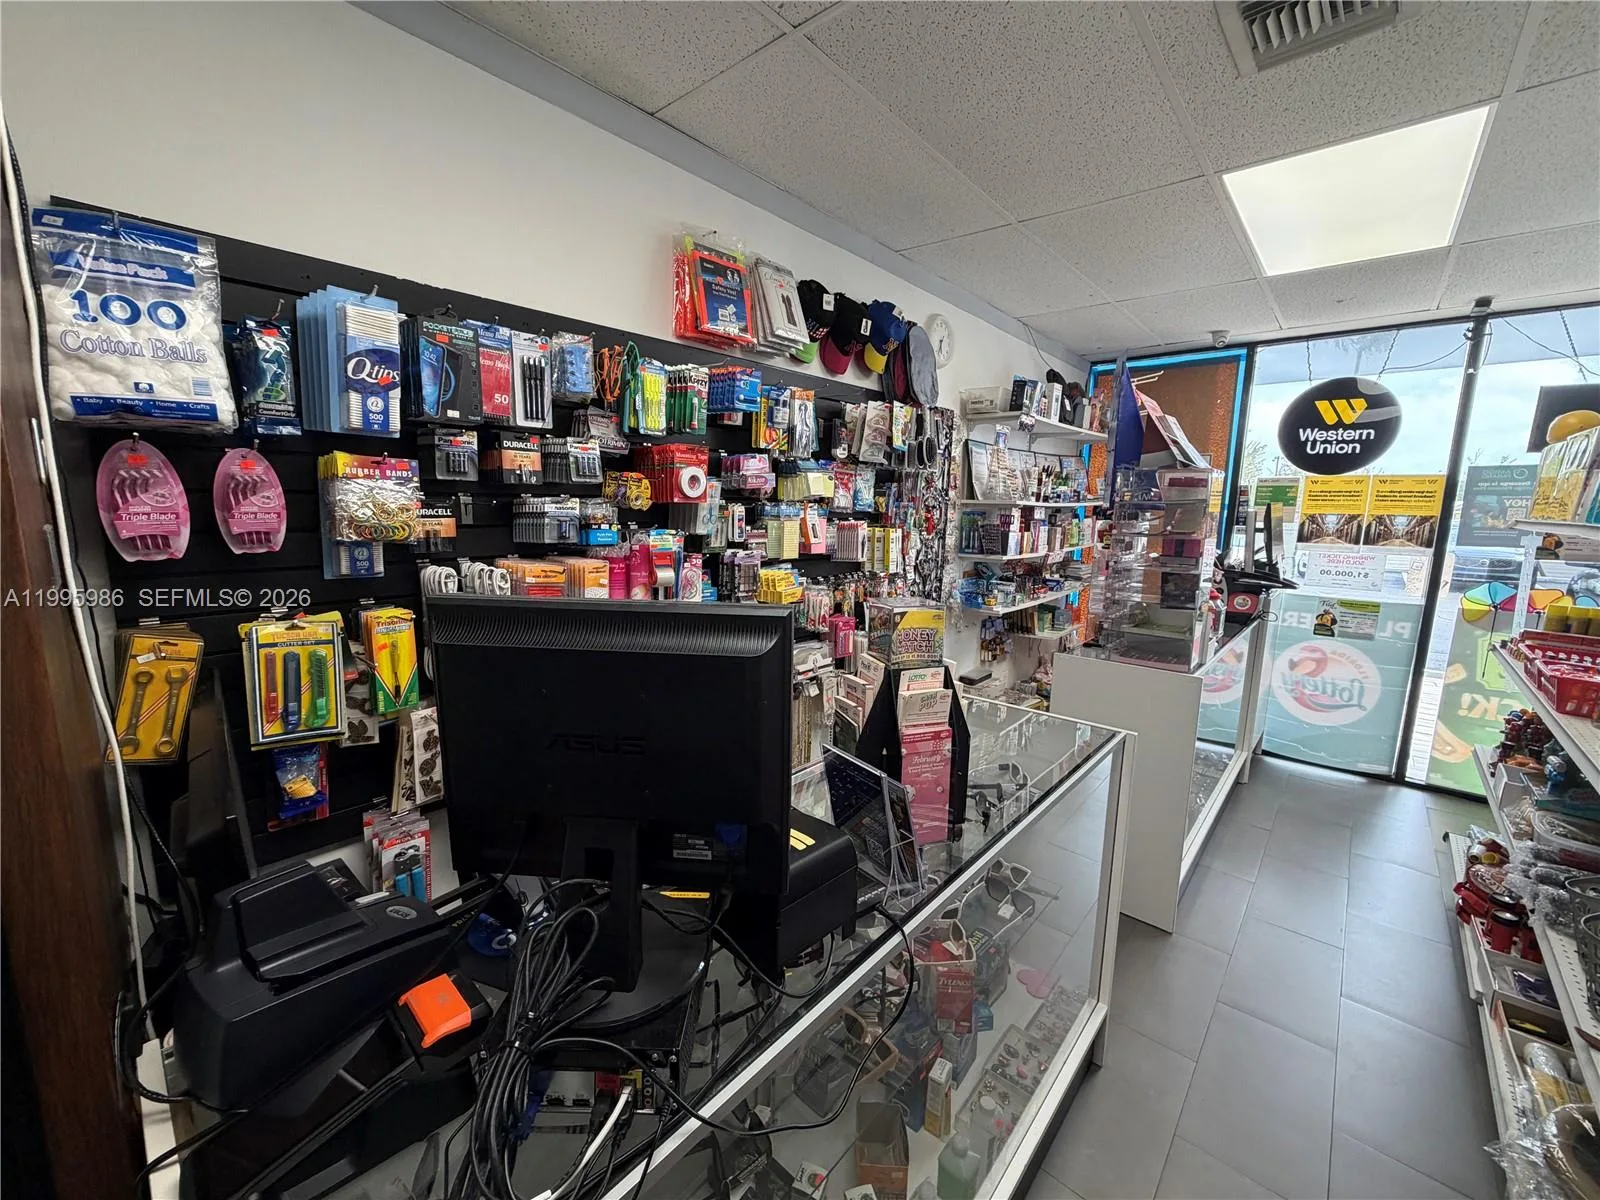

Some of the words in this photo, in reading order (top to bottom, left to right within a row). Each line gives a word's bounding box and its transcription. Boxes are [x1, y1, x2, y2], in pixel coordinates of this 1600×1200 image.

[127, 263, 168, 280] Pack
[70, 288, 188, 332] 100
[59, 328, 146, 358] Cotton
[150, 337, 209, 364] Balls
[82, 396, 104, 406] Baby
[116, 398, 144, 407] Beauty
[155, 400, 177, 409] Home
[188, 402, 211, 411] Crafts
[493, 393, 509, 405] 50
[368, 412, 384, 421] 500
[437, 436, 475, 446] Panonic
[1298, 427, 1375, 443] Western
[503, 440, 539, 450] DURACELL
[1305, 441, 1361, 455] Union
[345, 466, 381, 478] RUBBER
[386, 469, 413, 479] BANDS
[120, 512, 149, 523] Triple
[150, 511, 177, 521] Blade
[233, 512, 255, 521] Triple
[256, 512, 279, 521] Blade
[415, 508, 453, 516] URACELL
[911, 754, 942, 765] February
